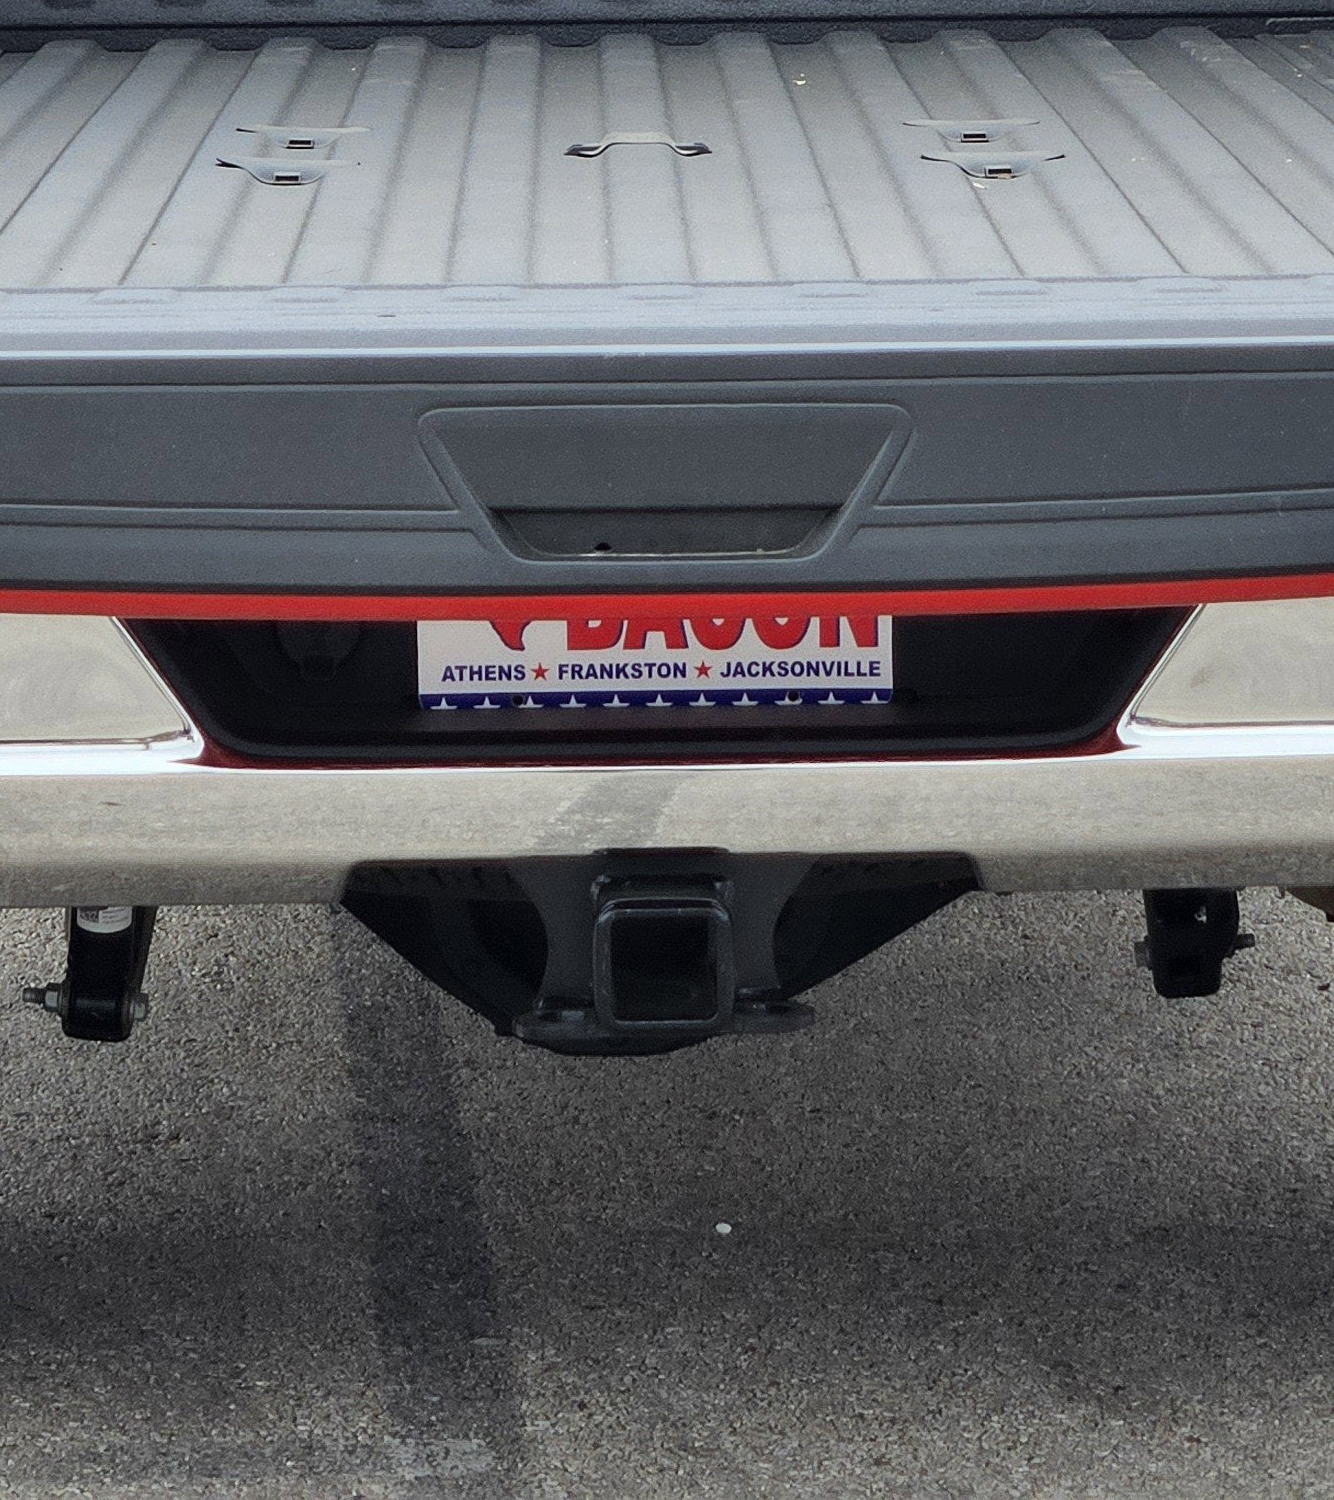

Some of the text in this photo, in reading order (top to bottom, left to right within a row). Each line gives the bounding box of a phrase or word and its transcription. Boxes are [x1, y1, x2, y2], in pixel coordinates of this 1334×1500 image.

[441, 660, 882, 682] ATHENS FRANKSTON JACKSONVILLE
